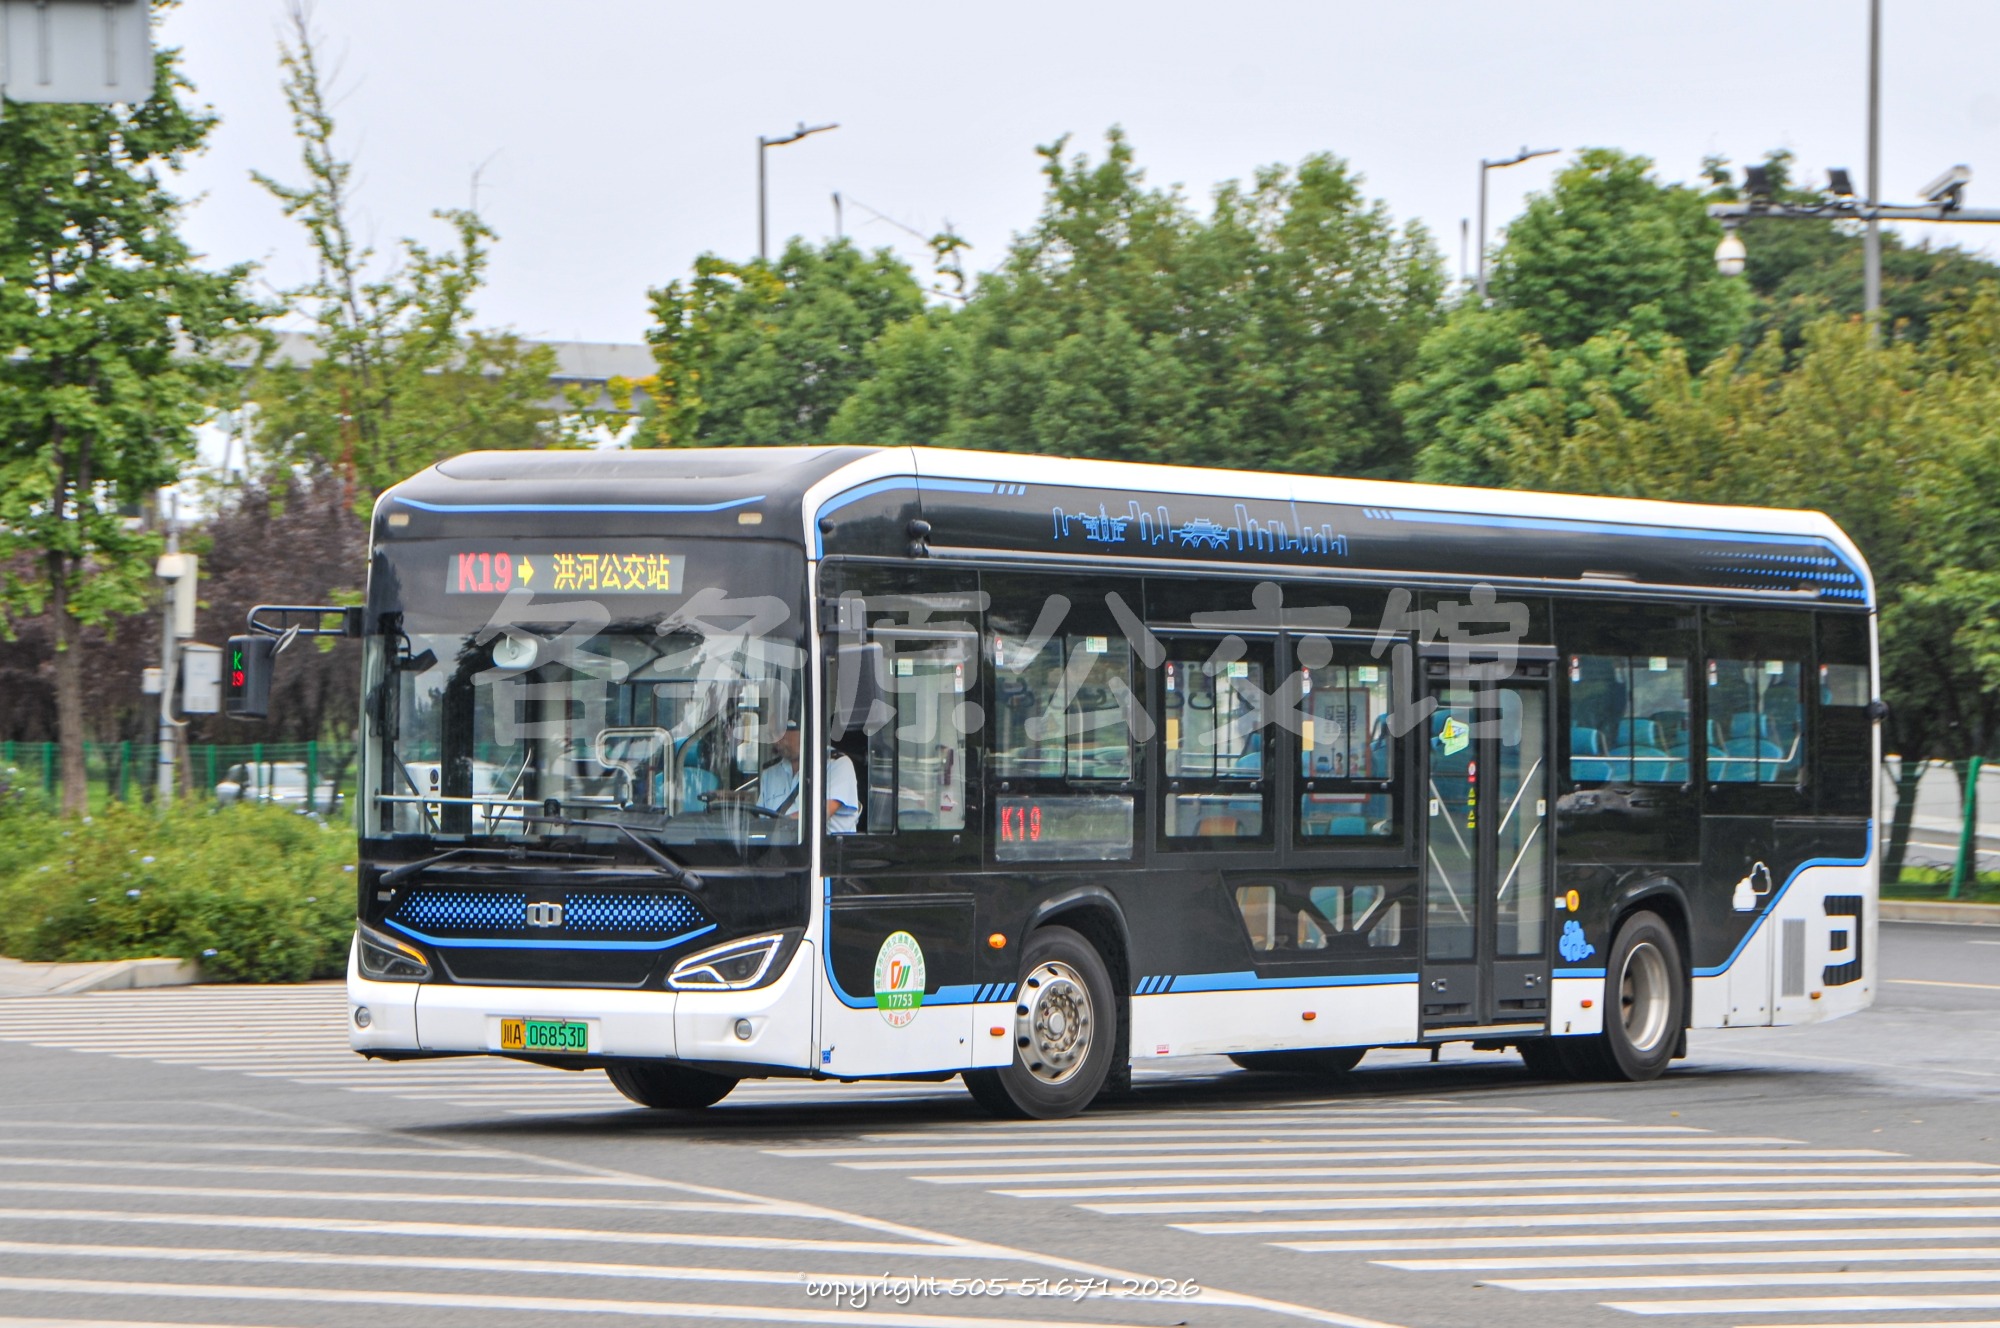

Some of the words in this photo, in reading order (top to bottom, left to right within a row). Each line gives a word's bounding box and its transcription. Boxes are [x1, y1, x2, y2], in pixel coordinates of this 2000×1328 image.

[458, 553, 512, 592] K19
[553, 553, 670, 591] 洪河公交站
[233, 650, 243, 670] K
[232, 671, 245, 687] 19
[1001, 806, 1041, 842] K19
[887, 993, 913, 1008] 17753
